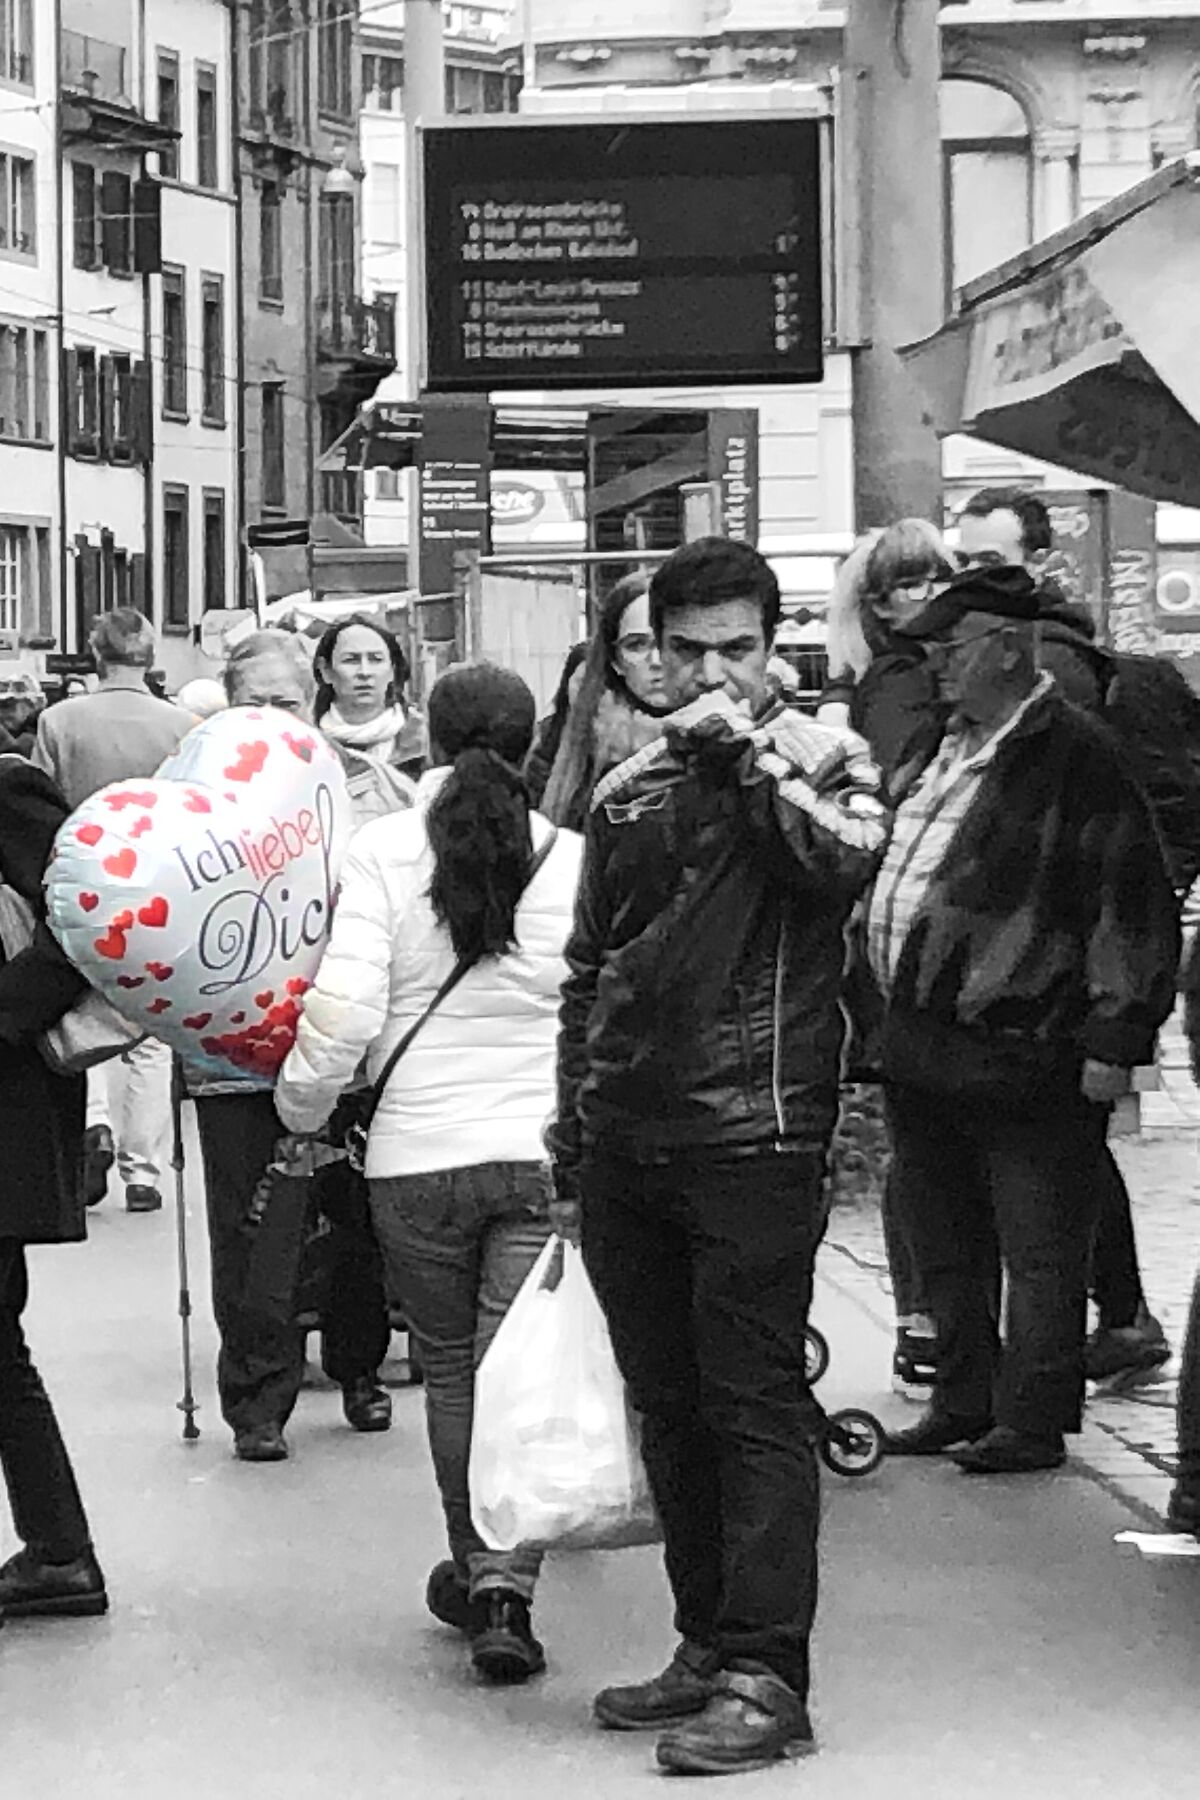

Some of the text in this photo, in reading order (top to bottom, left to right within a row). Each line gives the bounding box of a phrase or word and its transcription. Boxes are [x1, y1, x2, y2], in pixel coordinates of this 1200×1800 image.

[723, 437, 752, 541] arktplatz
[173, 808, 319, 891] Ich liebe
